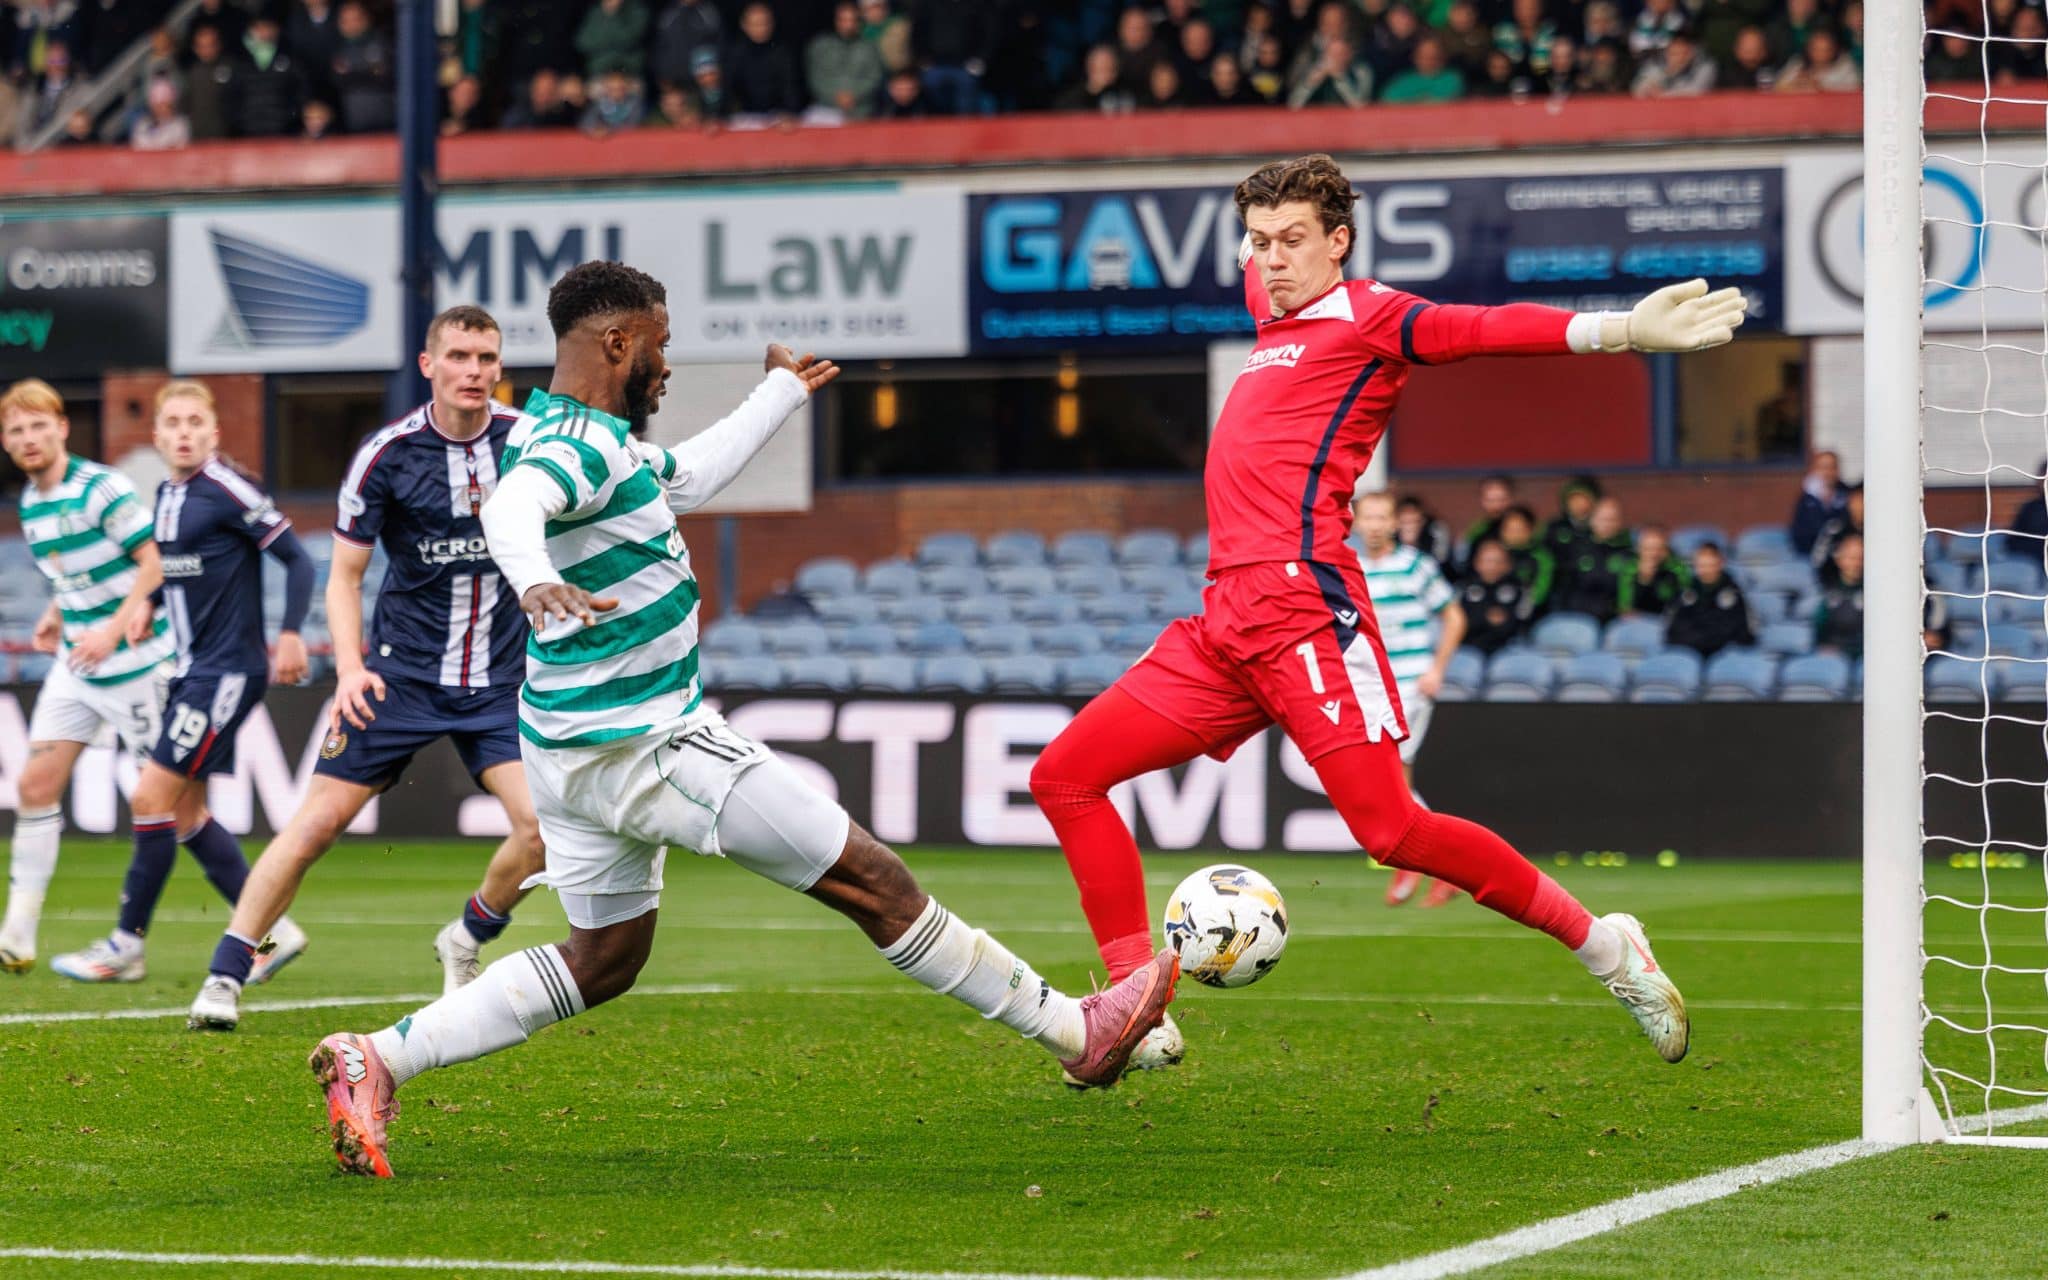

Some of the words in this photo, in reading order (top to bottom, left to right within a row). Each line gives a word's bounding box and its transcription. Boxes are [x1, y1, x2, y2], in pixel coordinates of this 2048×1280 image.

[706, 218, 914, 300] Law
[982, 186, 1454, 292] GAVIS
[10, 247, 157, 290] Comms
[1296, 642, 1326, 694] 1
[131, 702, 151, 735] 5
[168, 702, 209, 750] 19
